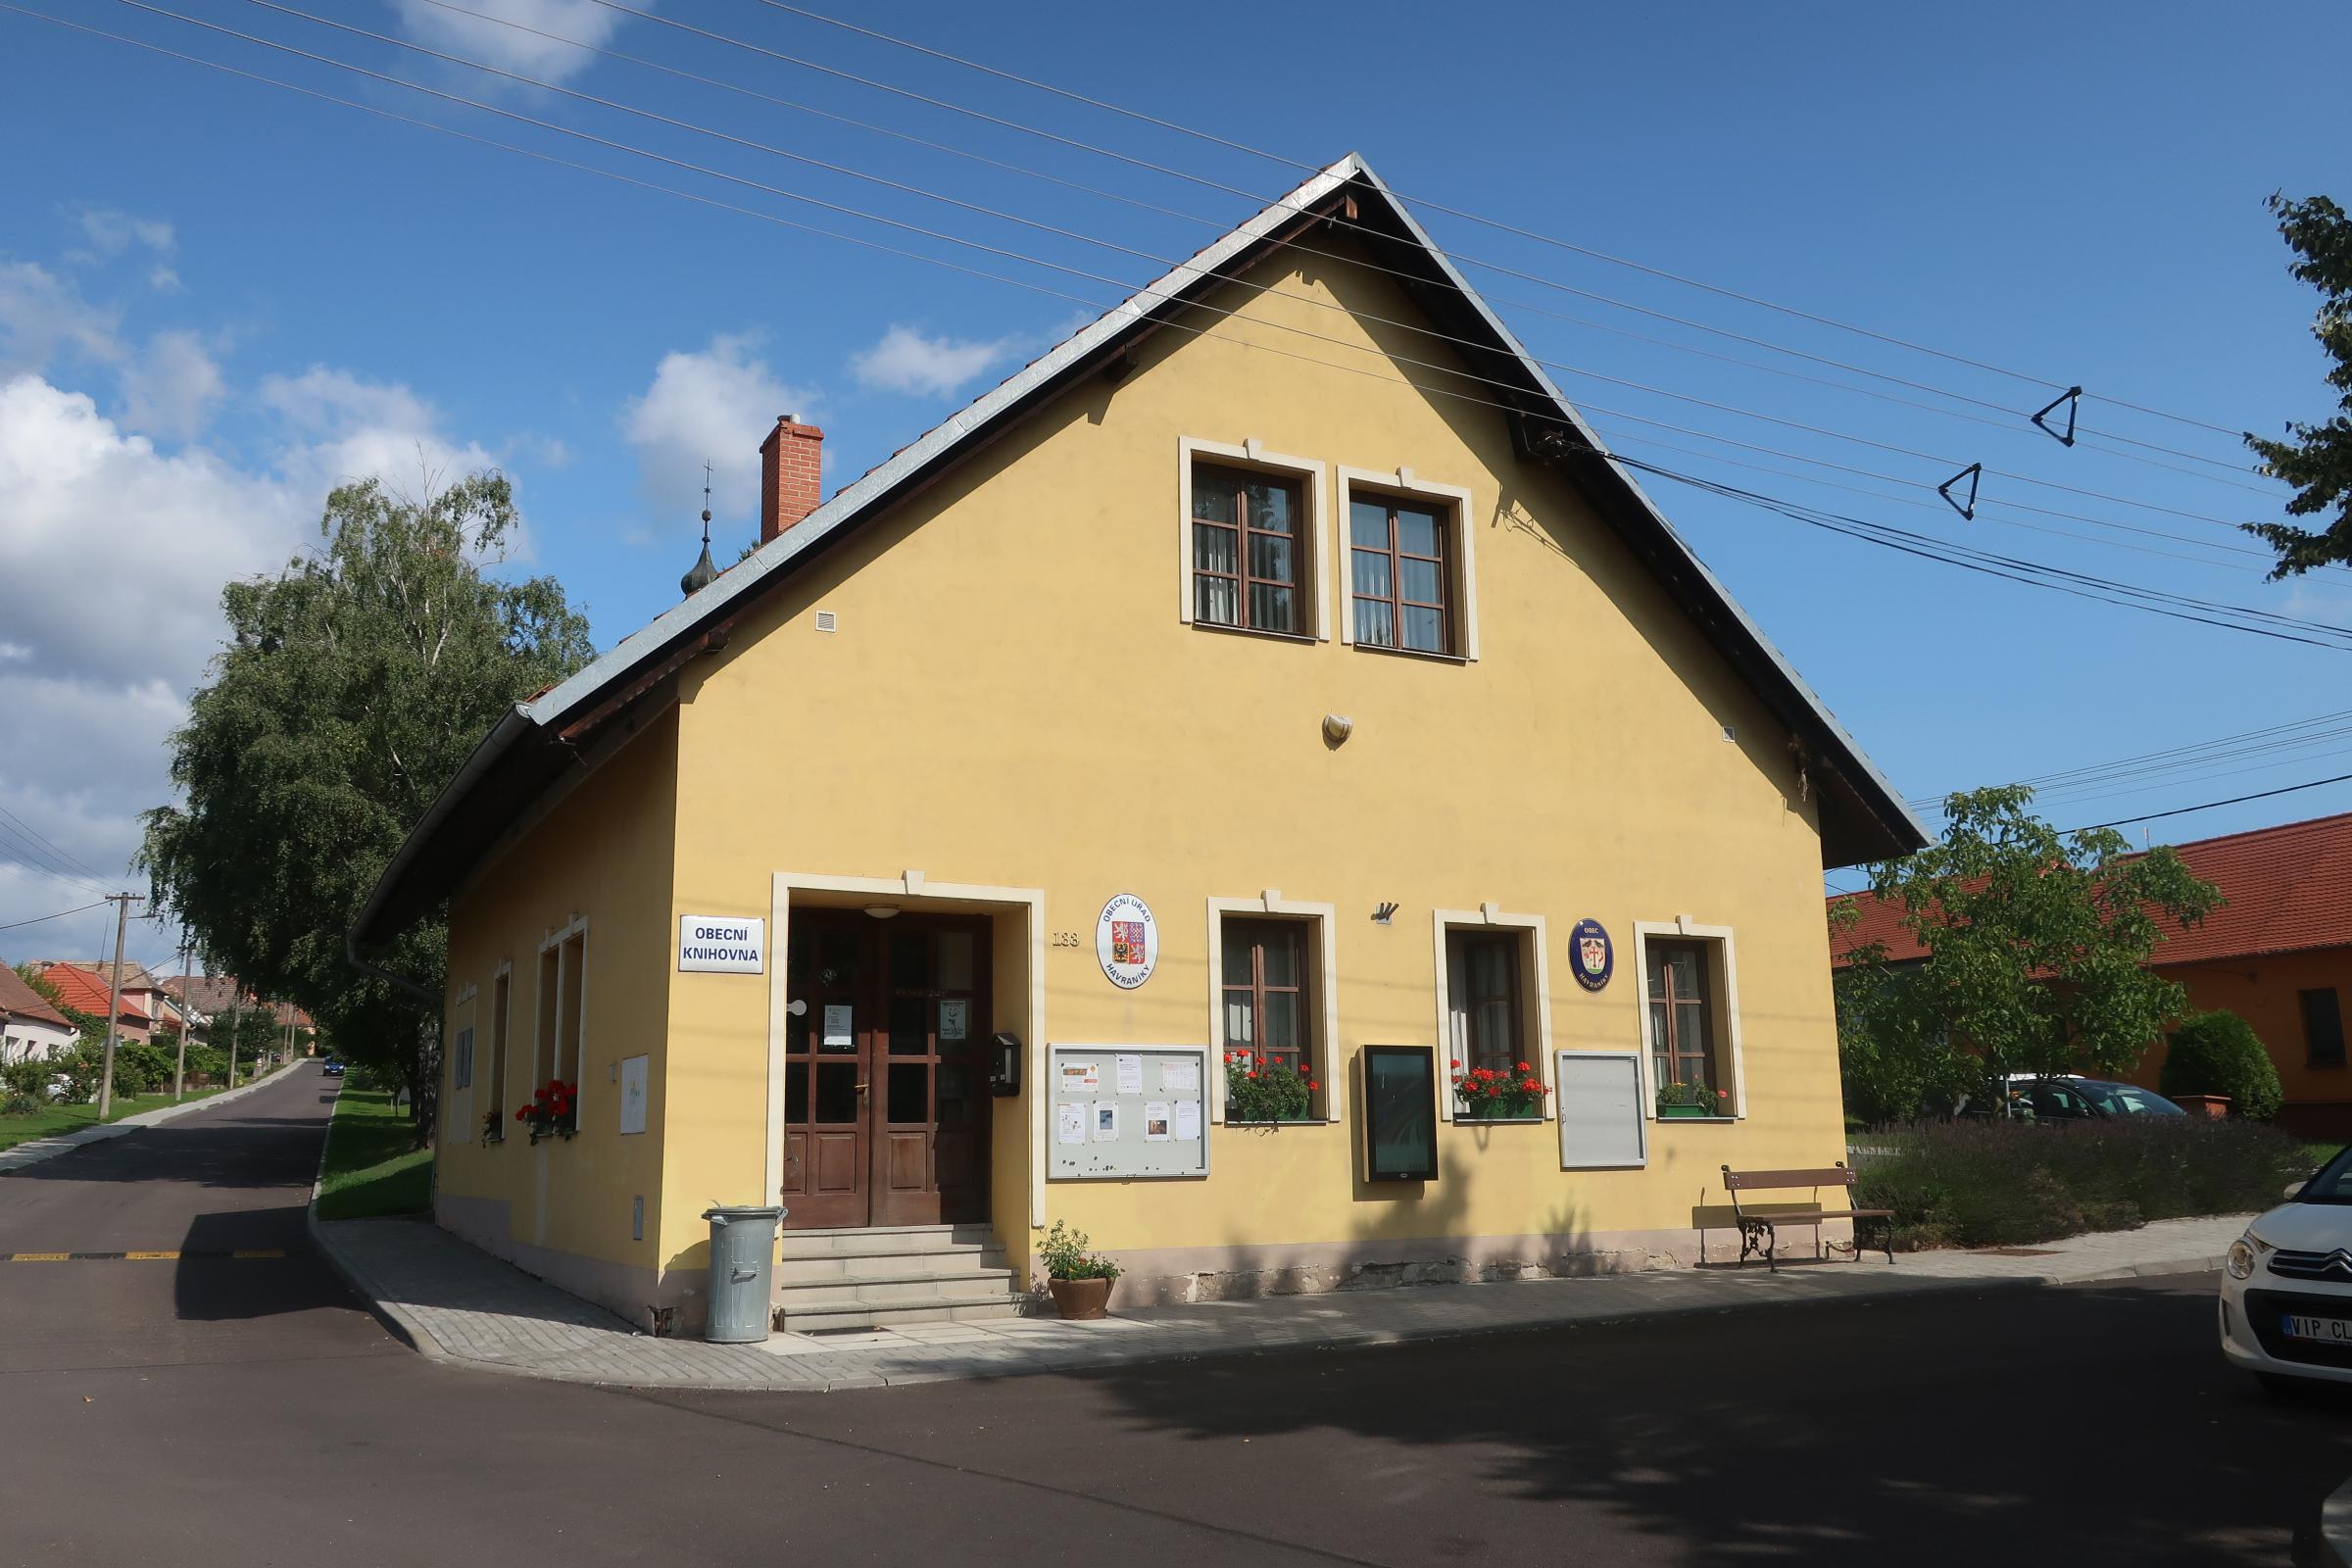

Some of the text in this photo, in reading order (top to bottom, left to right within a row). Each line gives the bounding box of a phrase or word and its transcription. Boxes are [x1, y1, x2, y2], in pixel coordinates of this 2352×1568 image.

[695, 926, 749, 942] OBECNÍ
[683, 947, 759, 961] KNIHOVNA
[1105, 962, 1151, 985] HAVRANÍKY
[2291, 1317, 2322, 1337] VIP
